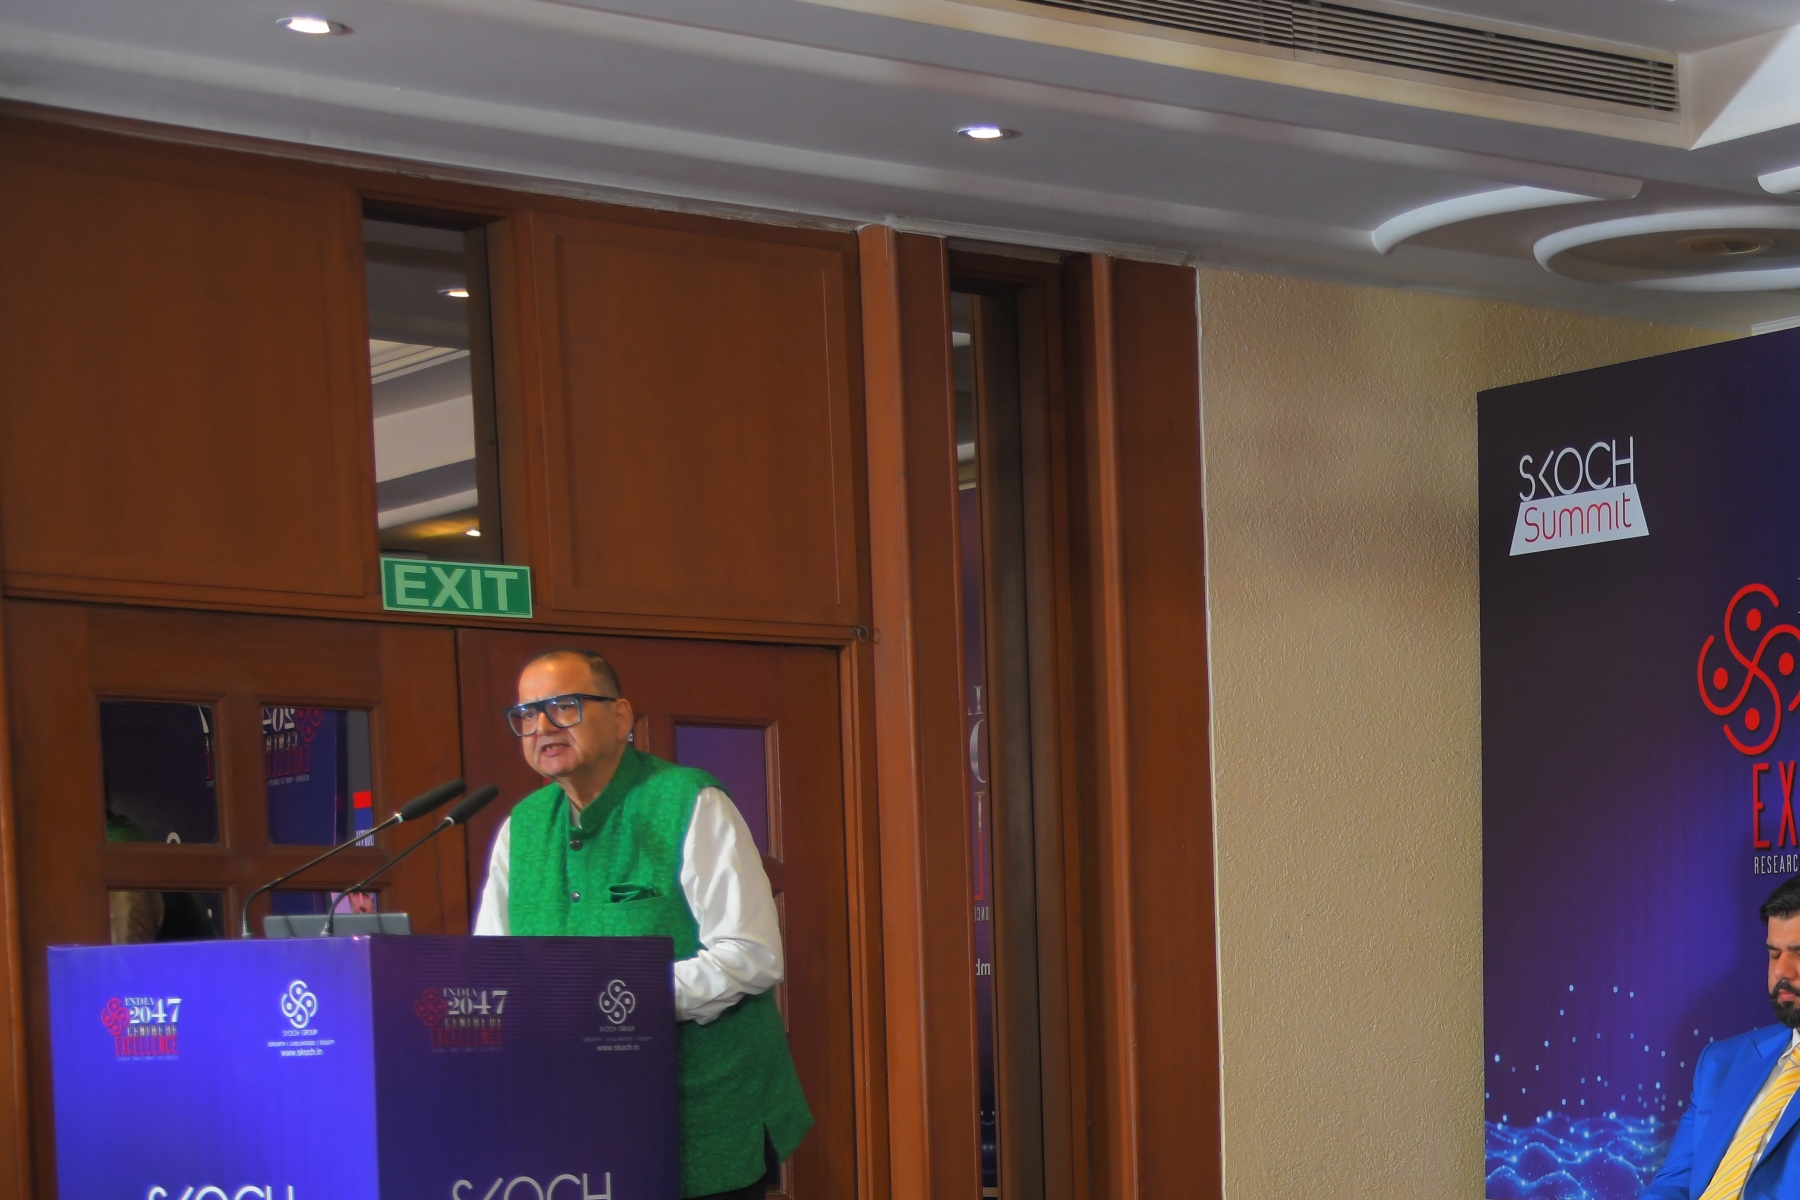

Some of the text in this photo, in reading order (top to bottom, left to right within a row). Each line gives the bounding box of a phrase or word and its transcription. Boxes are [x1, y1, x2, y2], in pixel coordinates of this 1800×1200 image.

[1518, 435, 1634, 502] SKOCH
[1524, 491, 1632, 543] Summit
[394, 563, 518, 611] EXIT
[129, 998, 182, 1024] 2047
[447, 990, 509, 1015] 2047
